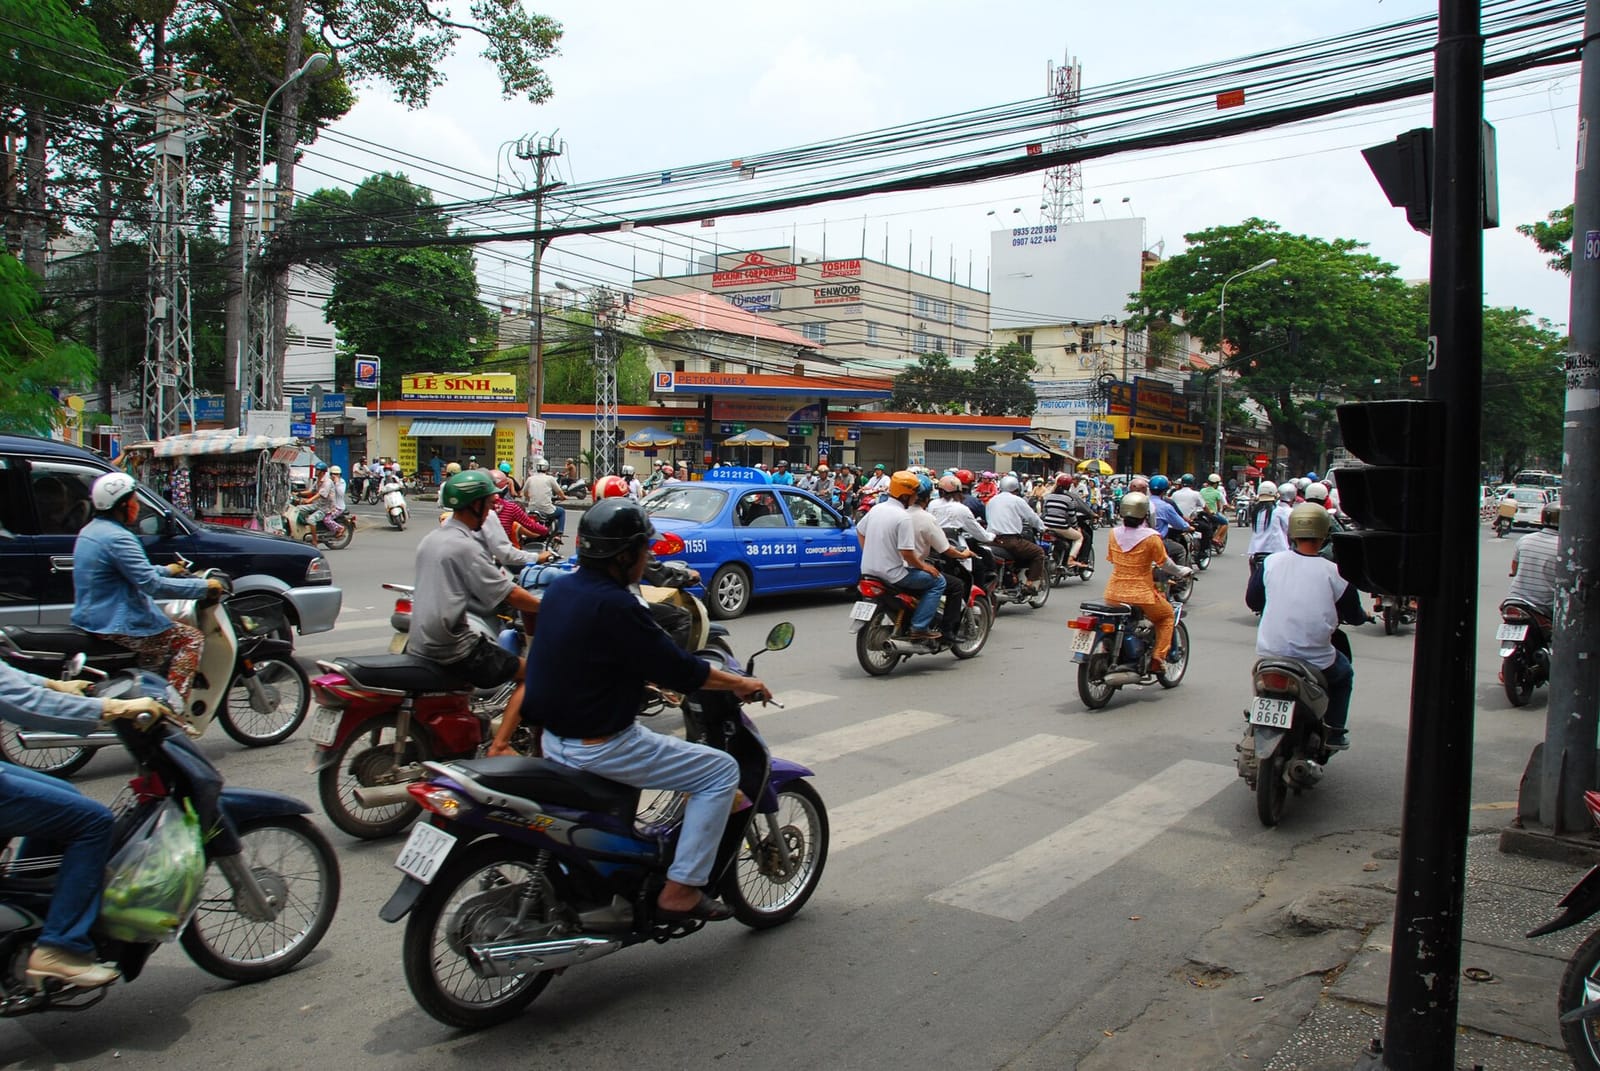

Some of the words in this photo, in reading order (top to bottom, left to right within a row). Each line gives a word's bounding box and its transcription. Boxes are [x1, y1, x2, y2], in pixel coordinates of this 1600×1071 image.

[1013, 227, 1029, 236] 0935
[1031, 226, 1043, 235] 220
[1012, 238, 1028, 246] 0907
[1044, 235, 1056, 243] 444
[822, 260, 861, 272] TOSHIBA
[745, 265, 796, 279] CORPORATION
[814, 285, 860, 297] KENWOOD
[444, 378, 490, 391] SINH
[678, 375, 746, 385] PETROLIMEX
[1040, 400, 1072, 409] PHOTOCOPY
[713, 470, 719, 478] 8
[720, 470, 731, 478] 21
[744, 471, 754, 479] 21
[747, 545, 759, 555] 38
[762, 545, 772, 555] 21
[774, 545, 785, 555] 21
[787, 544, 797, 554] 21
[1256, 711, 1287, 726] 8660
